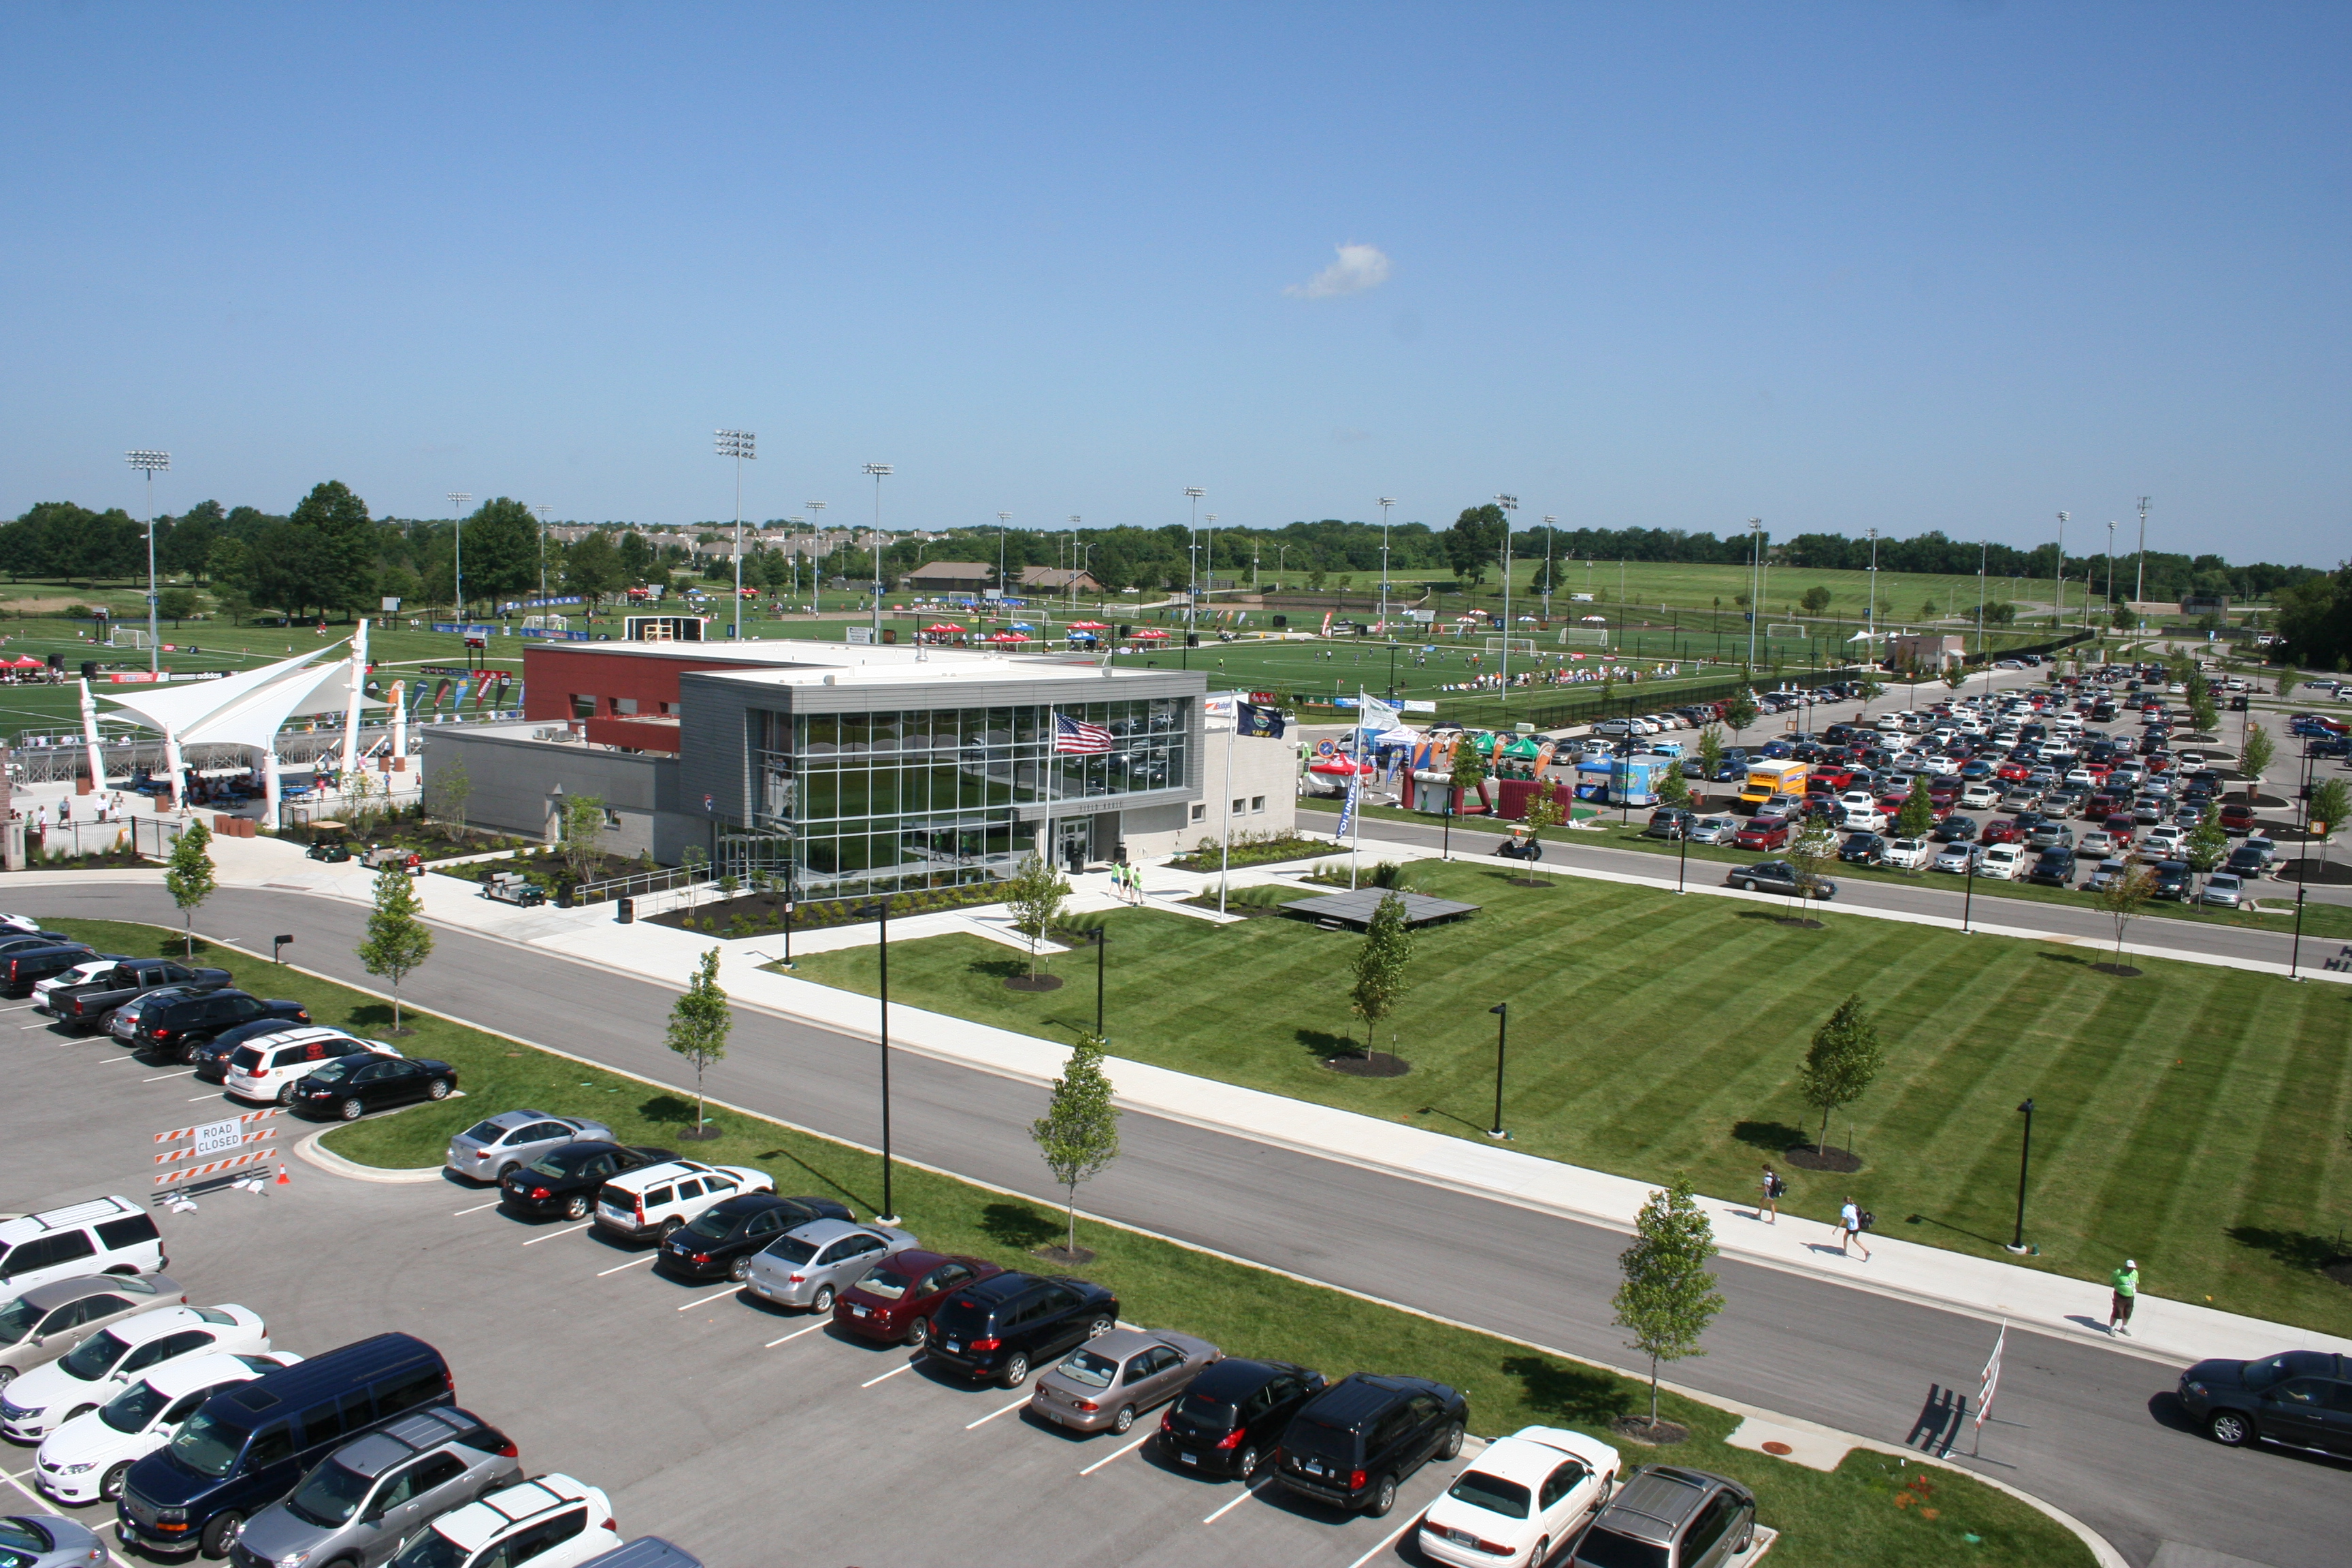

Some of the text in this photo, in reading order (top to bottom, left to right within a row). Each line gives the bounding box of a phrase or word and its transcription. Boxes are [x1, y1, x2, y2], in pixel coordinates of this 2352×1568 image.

[1216, 702, 1230, 710] Budge
[2313, 822, 2321, 832] B
[203, 1124, 233, 1139] ROAD
[198, 1134, 239, 1152] CLOSED
